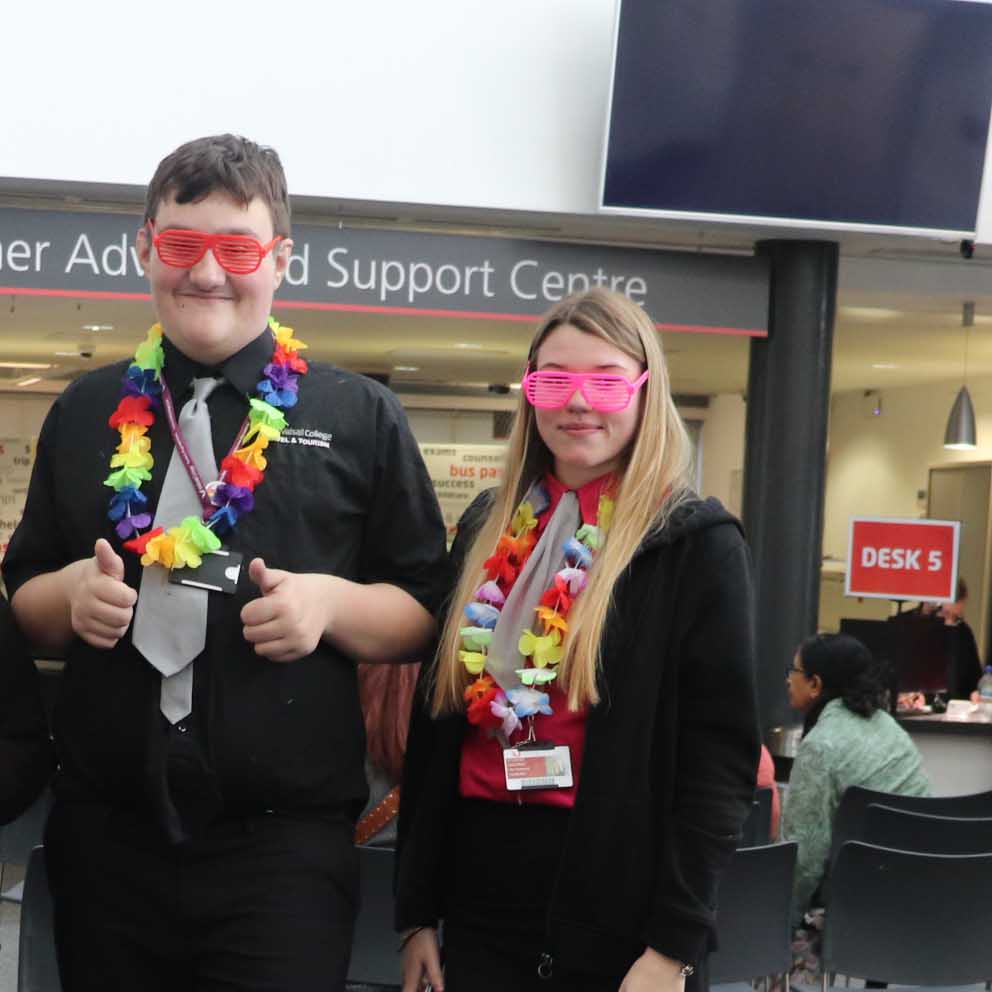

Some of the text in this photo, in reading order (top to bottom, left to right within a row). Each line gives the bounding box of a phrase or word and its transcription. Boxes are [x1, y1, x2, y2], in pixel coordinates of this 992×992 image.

[65, 233, 145, 277] Adv
[327, 248, 495, 302] Support
[450, 463, 475, 477] bus
[861, 546, 942, 572] DESK 5
